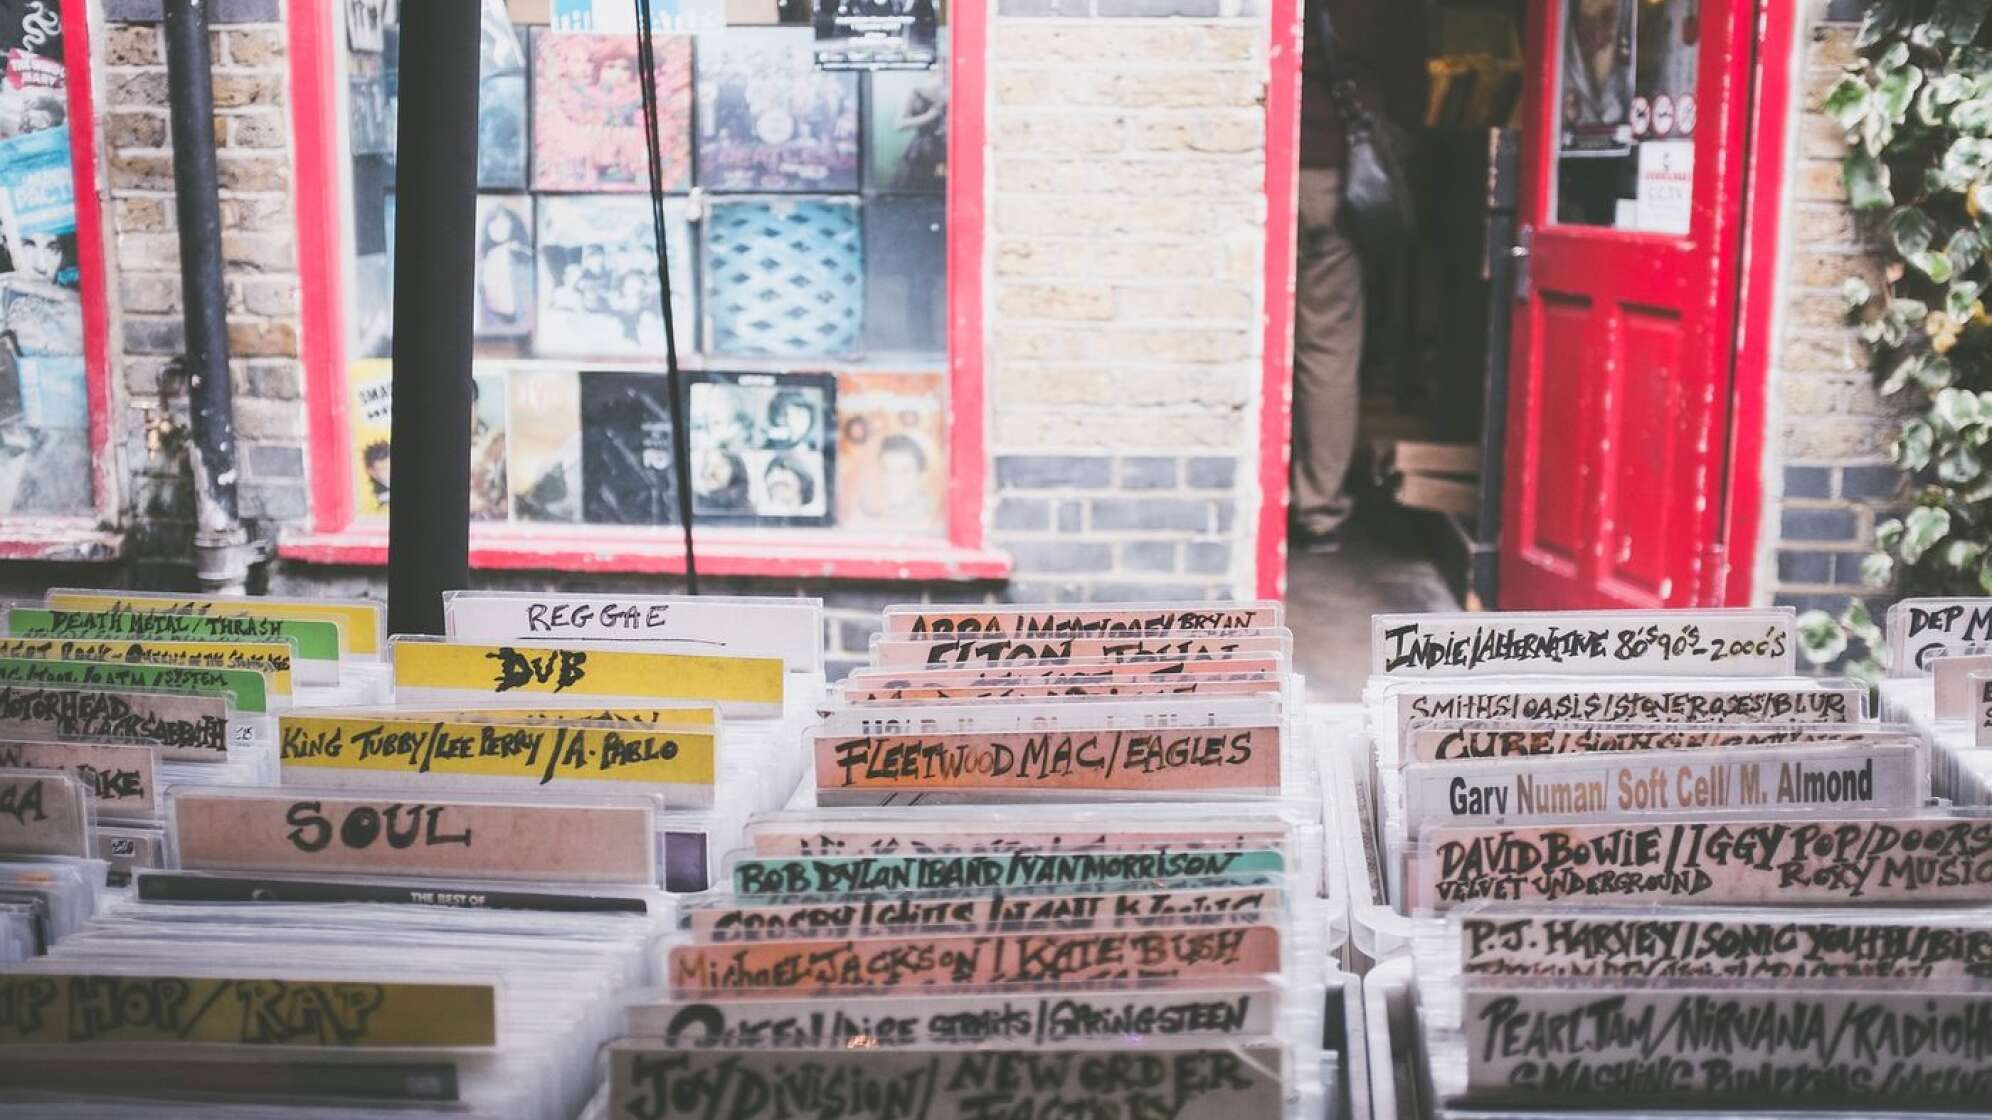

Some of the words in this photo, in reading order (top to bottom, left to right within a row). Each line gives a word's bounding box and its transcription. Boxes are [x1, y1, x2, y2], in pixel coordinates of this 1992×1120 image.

[130, 612, 189, 634] METAL
[205, 615, 283, 636] THRASH
[527, 603, 669, 631] REGGAE
[1908, 605, 1965, 638] DEP
[486, 647, 587, 693] DUB
[280, 727, 343, 759] KiNG
[834, 736, 1014, 788] FLEETWOOD
[1450, 775, 1508, 824] Gary
[1617, 766, 1668, 811] Soft
[1740, 763, 1768, 805] M.
[1776, 757, 1873, 804] Almond
[286, 801, 472, 852] SOUL
[733, 861, 811, 893] BOB
[1437, 831, 1541, 879] DAVID
[410, 891, 433, 905] THE
[439, 893, 466, 907] BEST
[1435, 874, 1527, 901] VELVET
[1531, 867, 1712, 900] UNDERGROUND
[1777, 856, 1880, 897] ROXY
[1013, 935, 1128, 978] KATE
[1131, 930, 1247, 966] BUSH
[945, 1050, 1070, 1093] NEW
